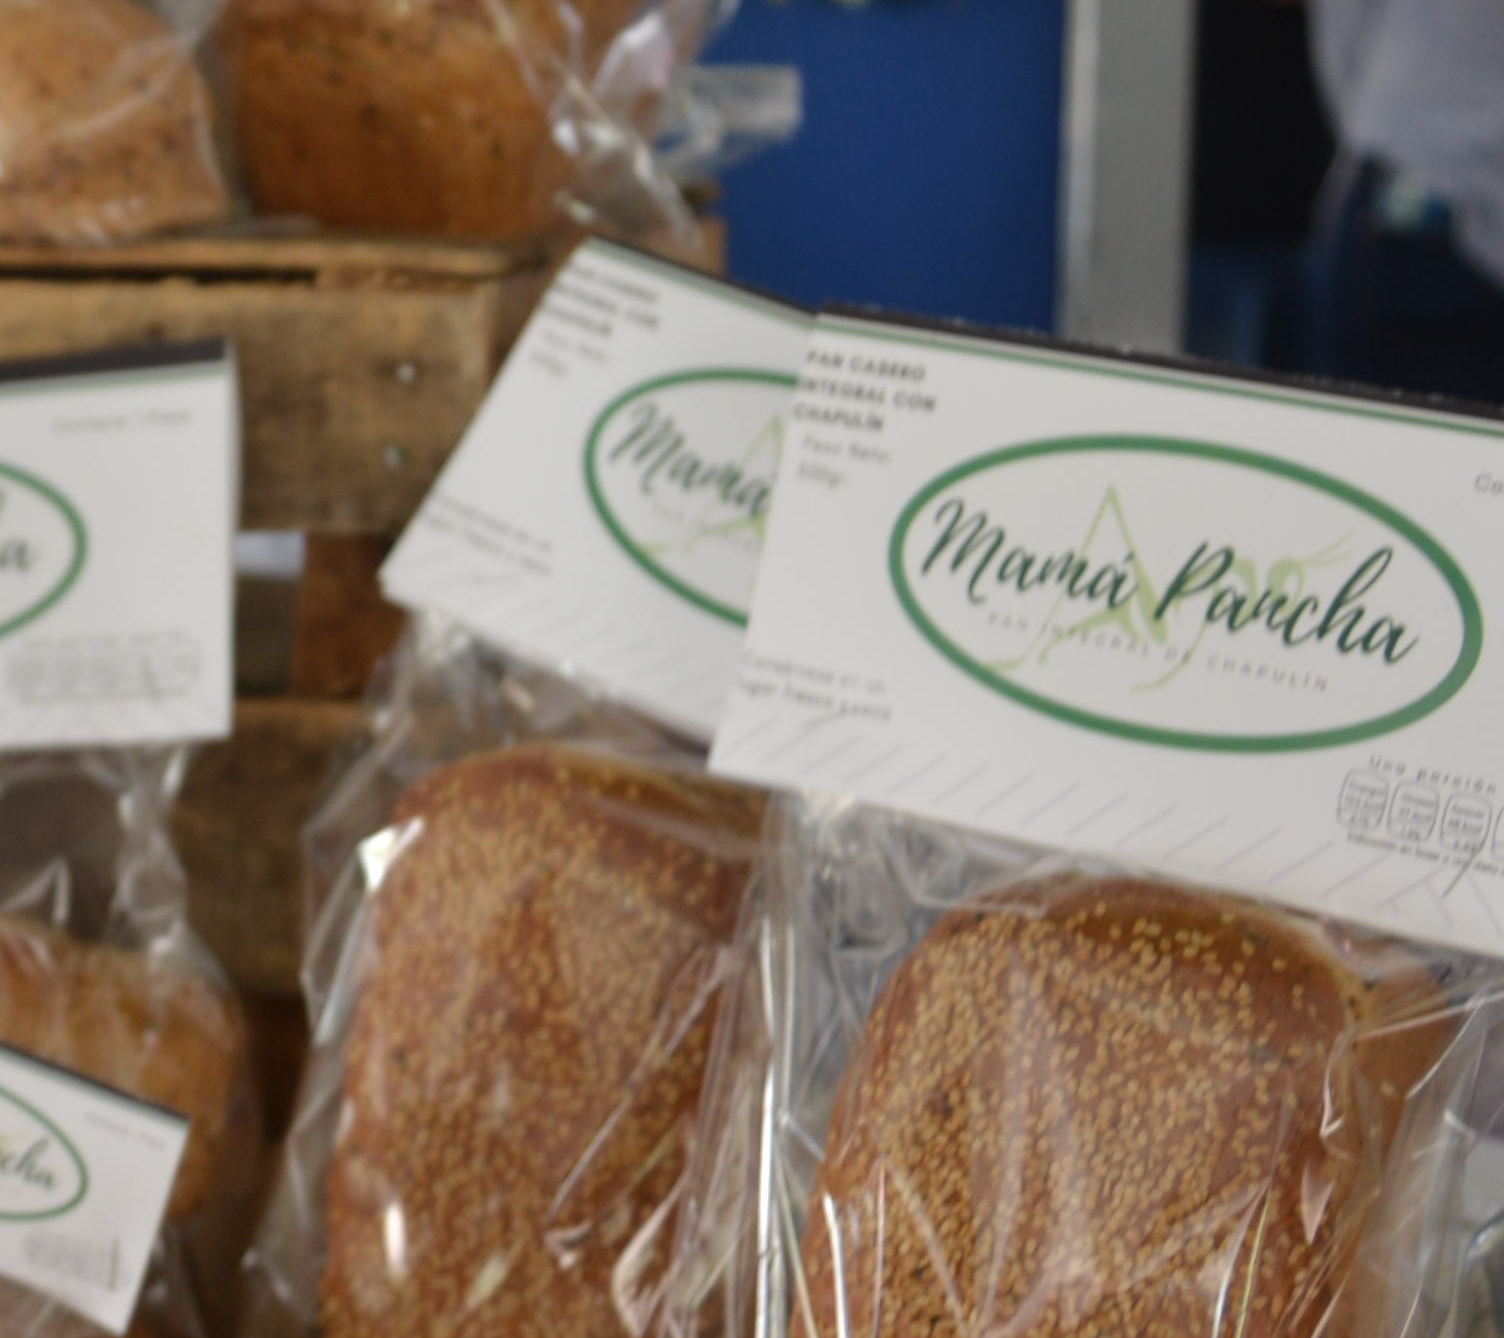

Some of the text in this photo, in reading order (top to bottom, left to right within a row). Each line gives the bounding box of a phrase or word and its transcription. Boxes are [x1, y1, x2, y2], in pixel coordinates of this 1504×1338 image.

[806, 349, 843, 368] PAN
[920, 497, 1420, 666] Mamá Pancha
